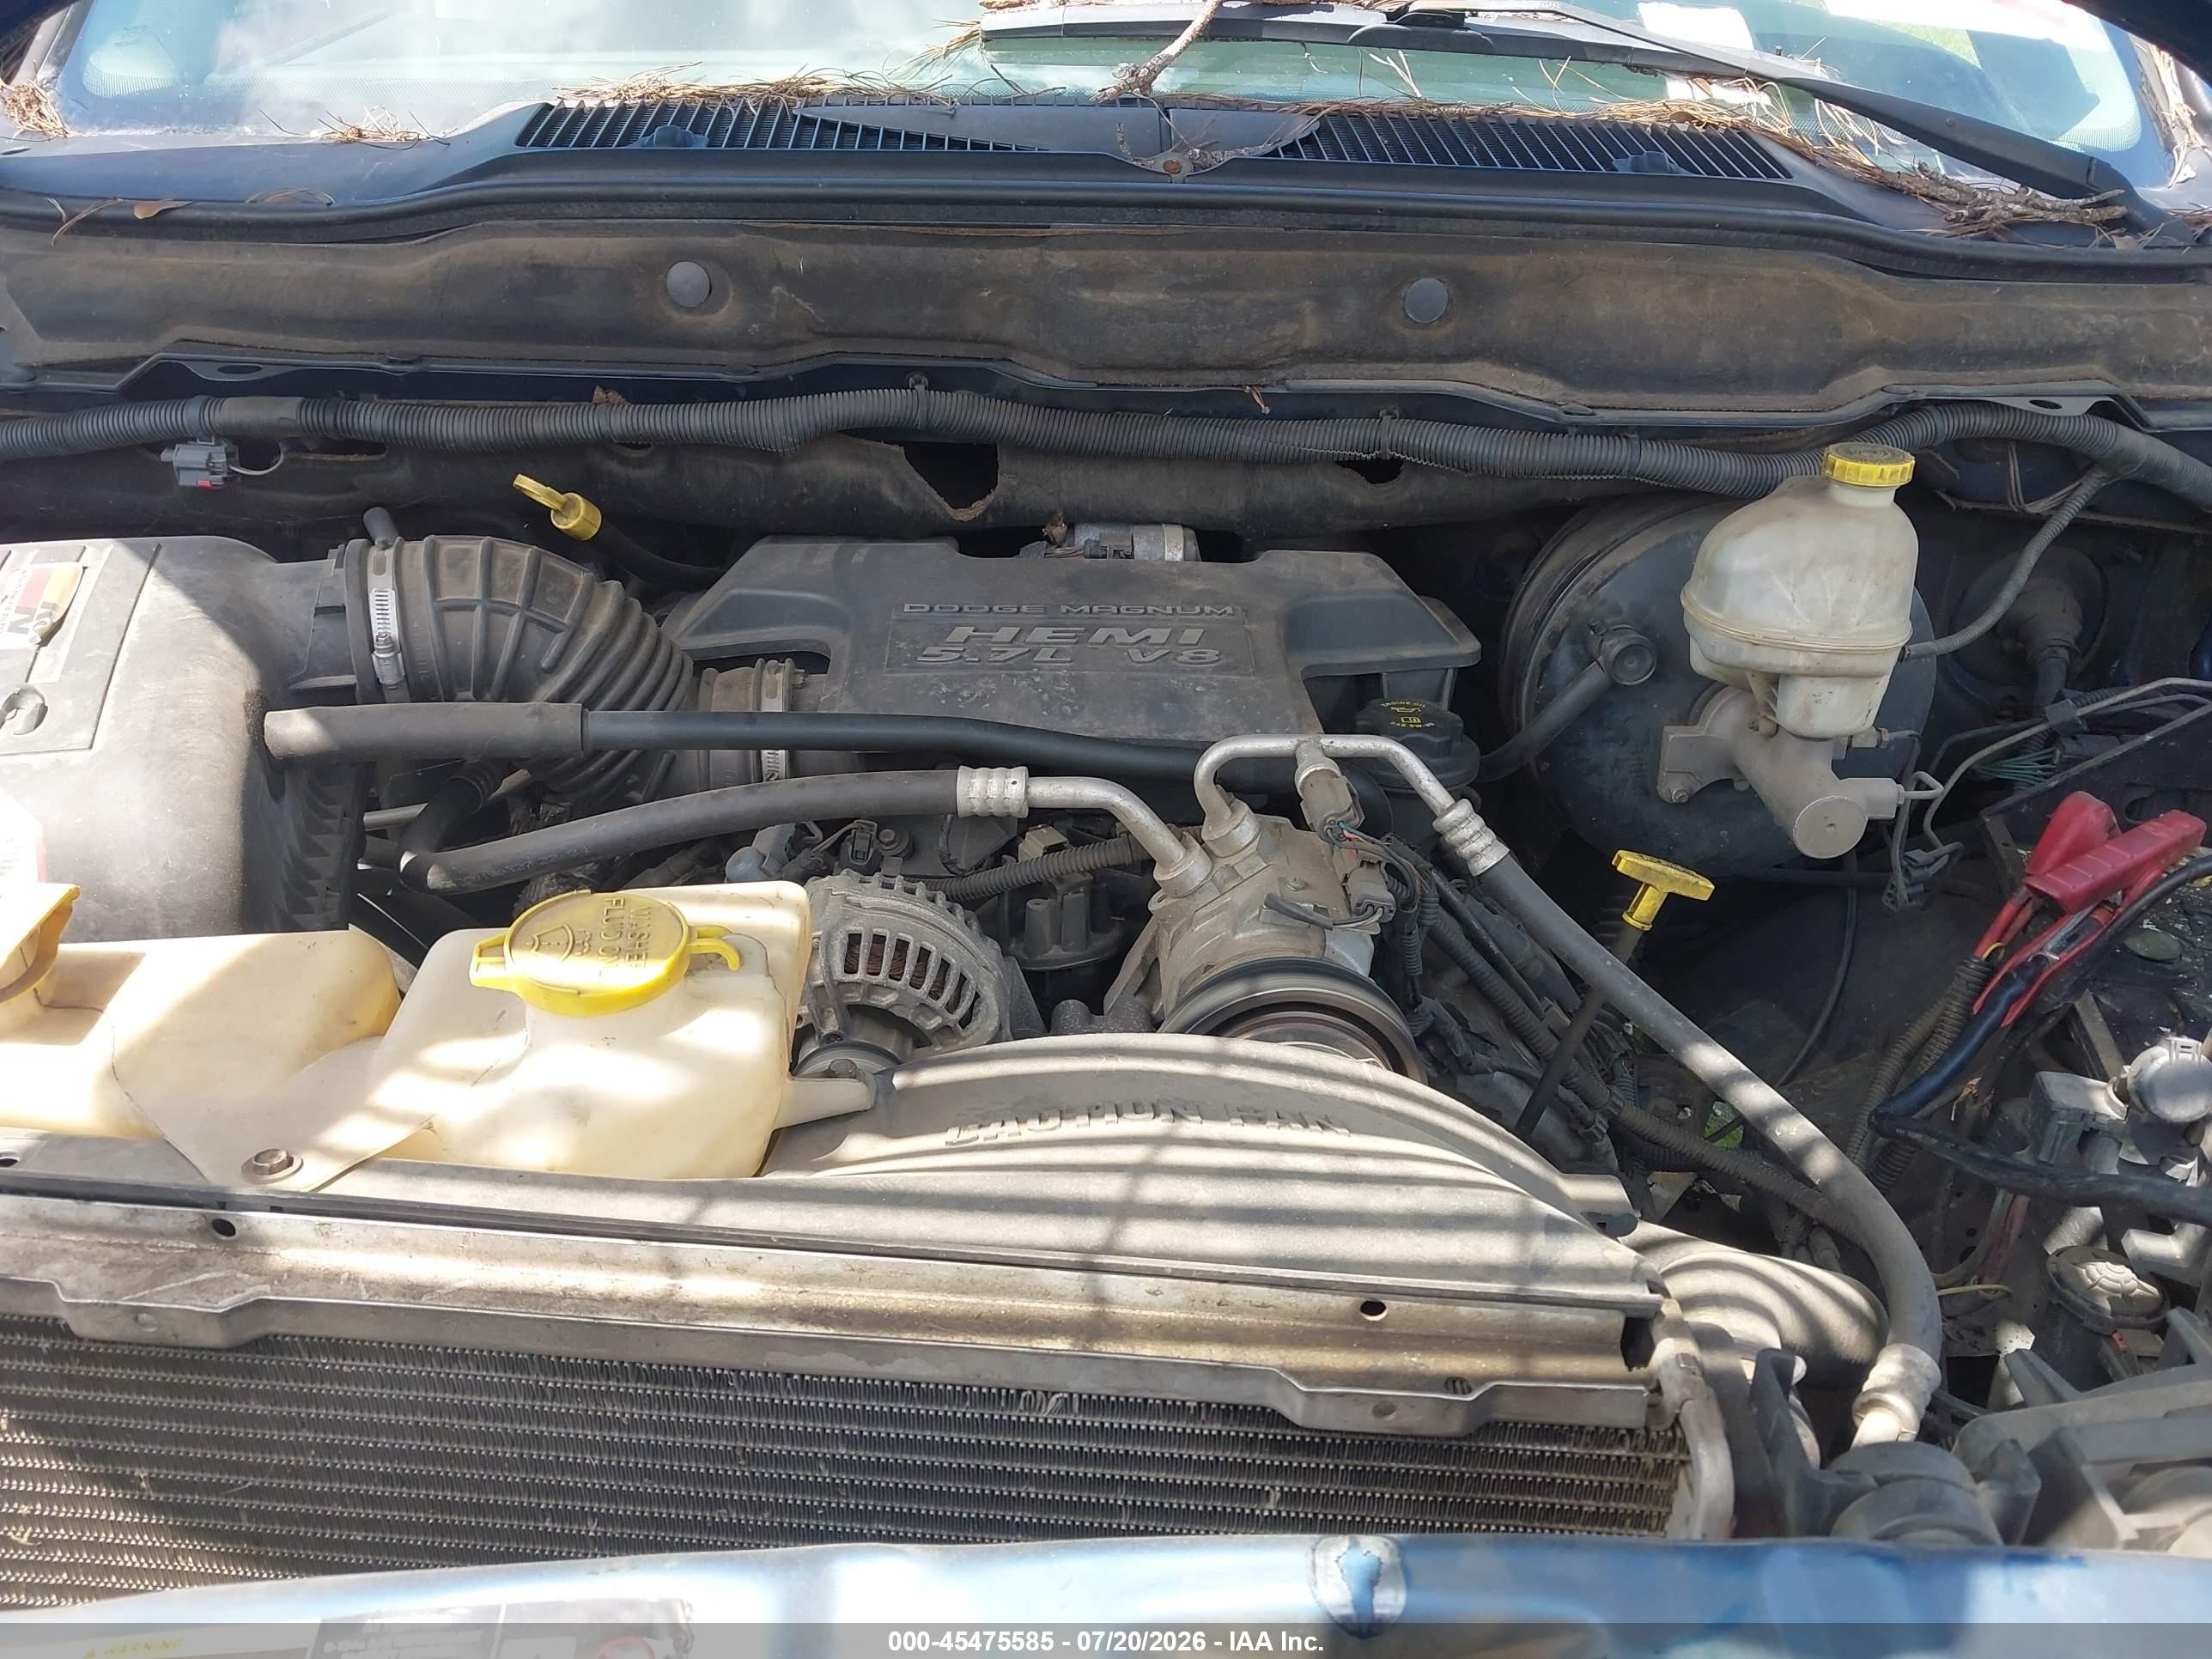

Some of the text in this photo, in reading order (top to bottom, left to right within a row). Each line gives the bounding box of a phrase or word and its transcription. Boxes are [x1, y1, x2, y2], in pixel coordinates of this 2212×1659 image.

[903, 603, 1234, 616] DODGE MAGNUM
[944, 626, 1206, 646] HEMI
[916, 646, 1223, 665] 5.7L V8
[599, 896, 626, 942] FLUID
